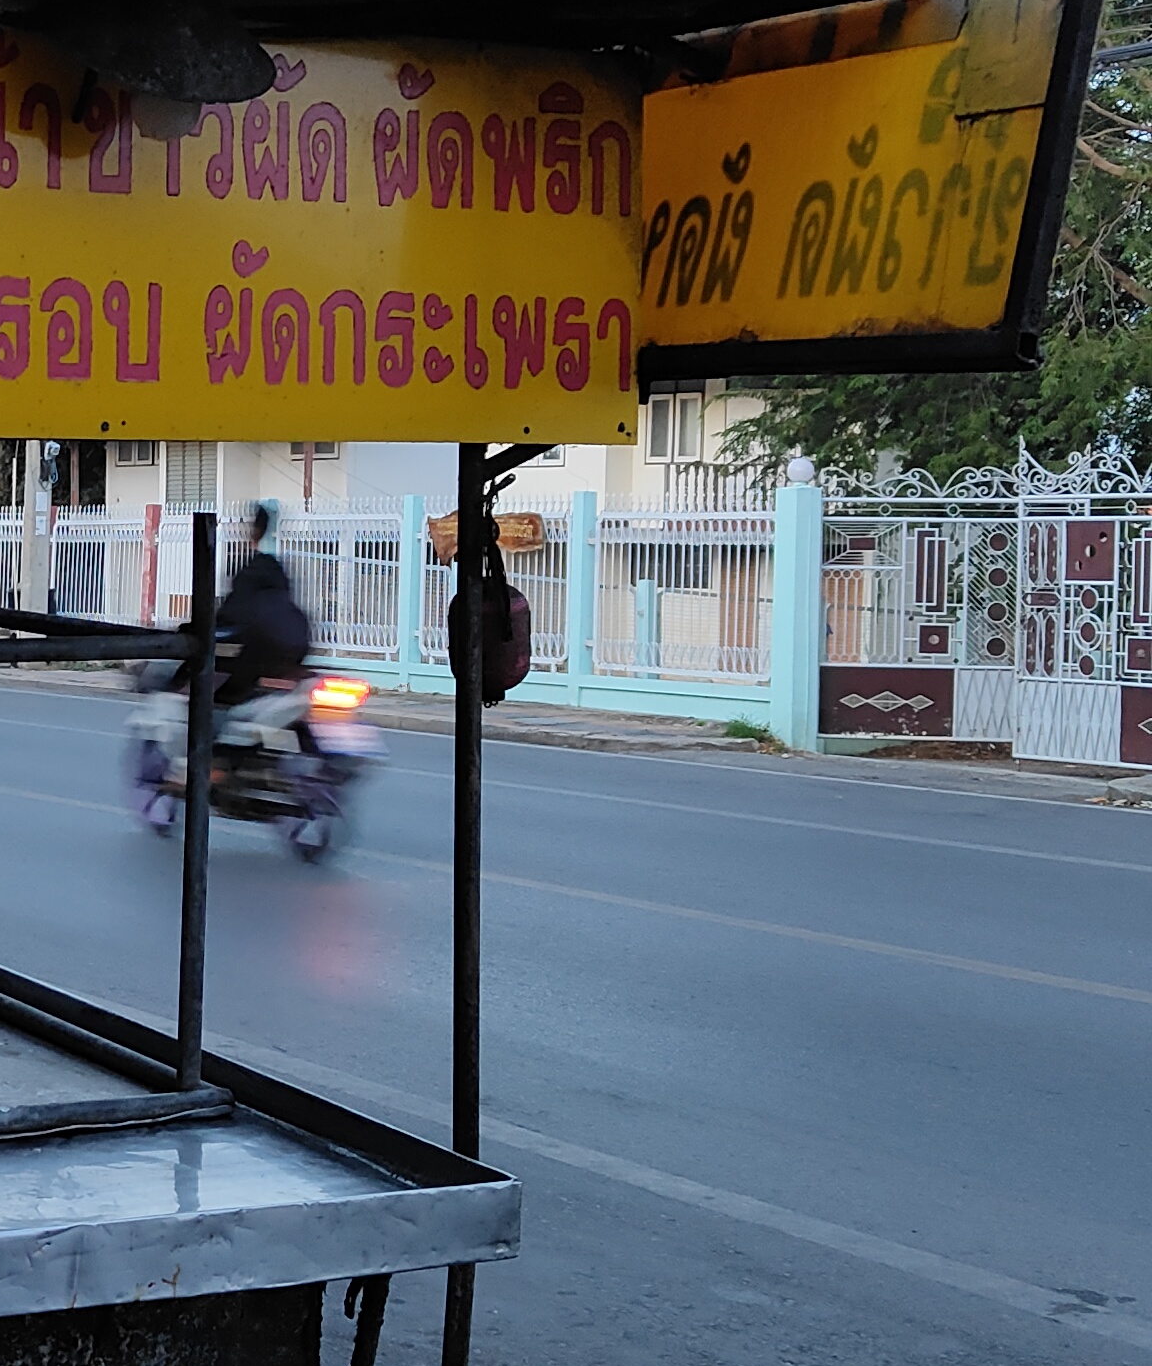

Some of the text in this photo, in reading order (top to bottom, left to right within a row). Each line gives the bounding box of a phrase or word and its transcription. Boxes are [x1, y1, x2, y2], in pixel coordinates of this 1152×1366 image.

[84, 52, 347, 202] ขวผัด
[373, 62, 632, 217] ผัดพริก
[204, 239, 631, 392] ผัดกระเพรา
